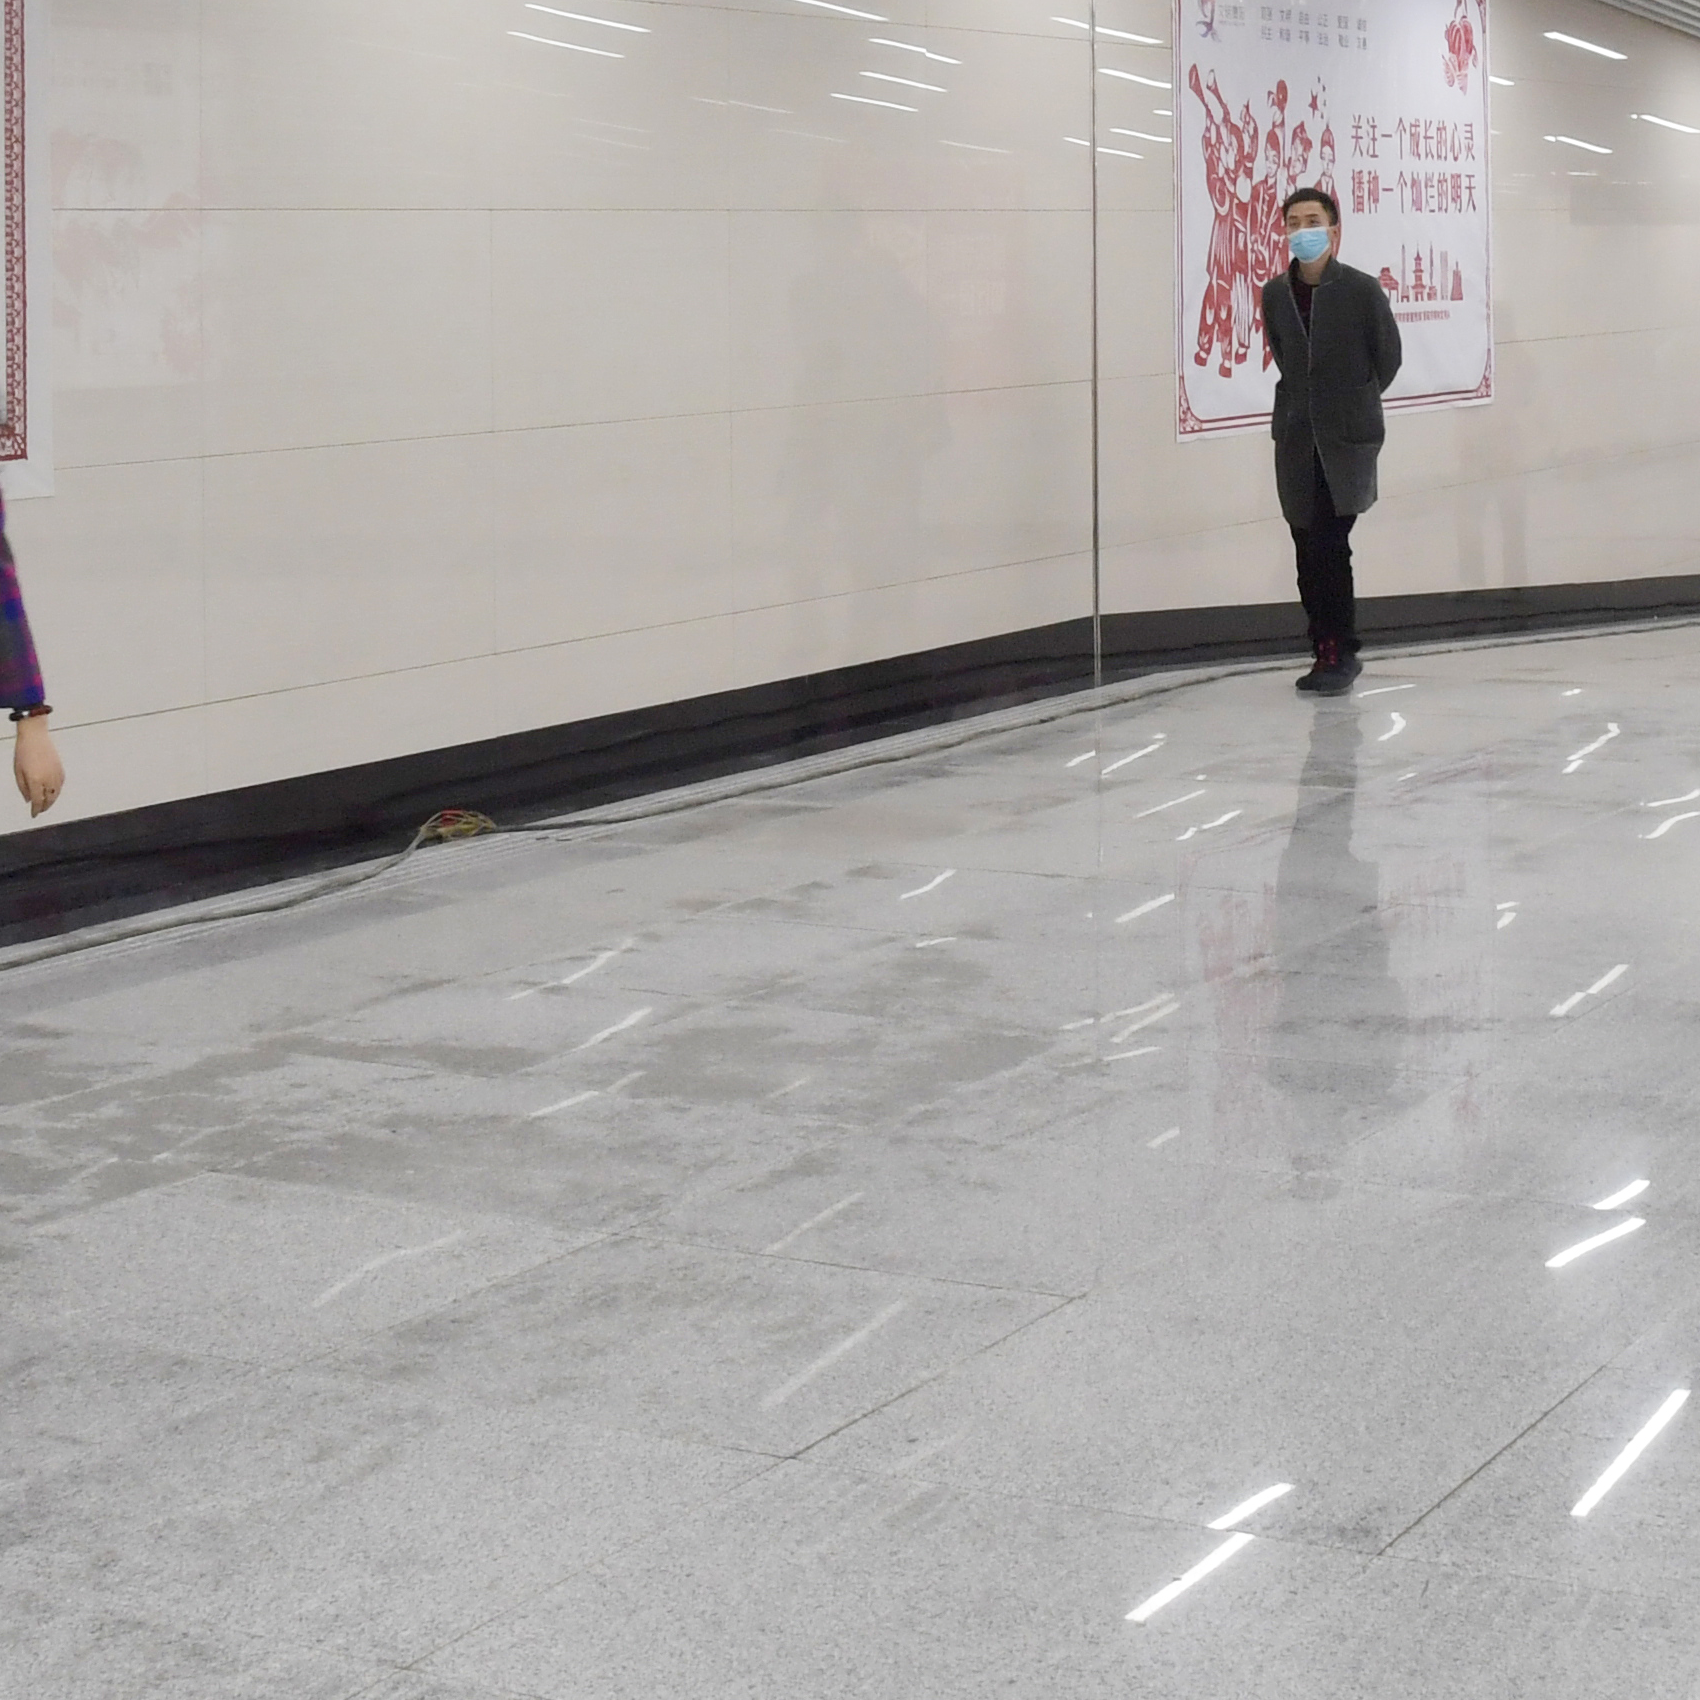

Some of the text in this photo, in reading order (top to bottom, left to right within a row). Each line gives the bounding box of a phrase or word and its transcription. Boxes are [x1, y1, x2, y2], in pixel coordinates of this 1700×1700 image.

[1351, 113, 1476, 162] 关注一个成长的心灵
[1351, 168, 1477, 215] 播种一个灿烂的明天
